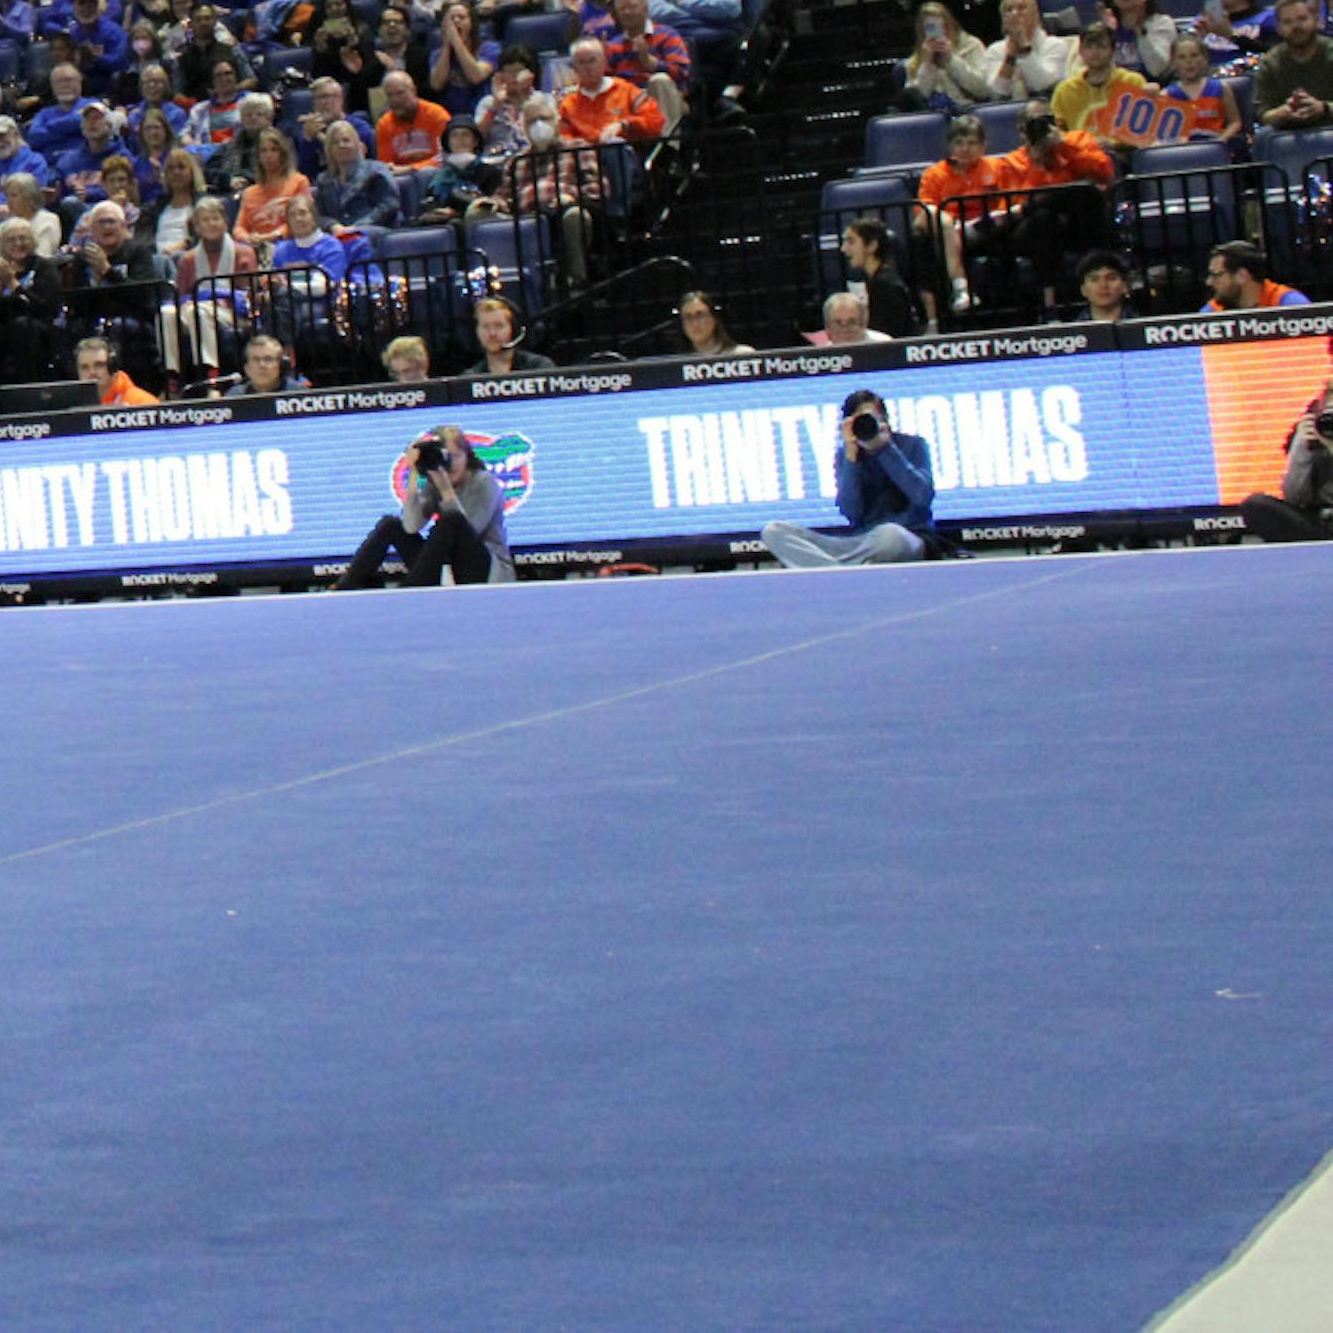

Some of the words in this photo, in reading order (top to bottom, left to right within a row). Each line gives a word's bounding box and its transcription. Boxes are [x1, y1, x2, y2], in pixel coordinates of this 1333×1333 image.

[1114, 94, 1184, 141] 100
[1145, 321, 1234, 345] ROCKET
[1238, 312, 1333, 338] Mortgage
[472, 377, 548, 399] ROCKET
[550, 372, 633, 393] Mortgage
[682, 358, 763, 382] ROCKET
[765, 352, 853, 376] Mortgage
[906, 340, 991, 364] ROCKET
[993, 332, 1088, 357] Mortgage
[275, 395, 347, 416] ROCKET
[348, 388, 427, 410] Mortgage
[91, 410, 158, 431] ROCKET
[160, 406, 233, 427] Mortgage
[638, 401, 841, 508] TRINITY
[99, 448, 294, 545] THOMAS
[961, 528, 1020, 542] ROCKET
[1021, 524, 1086, 540] Mortgage
[513, 551, 565, 566] ROCKET
[566, 549, 623, 564] Mortgage
[121, 572, 167, 587] ROCKET
[167, 570, 218, 586] Mortgage
